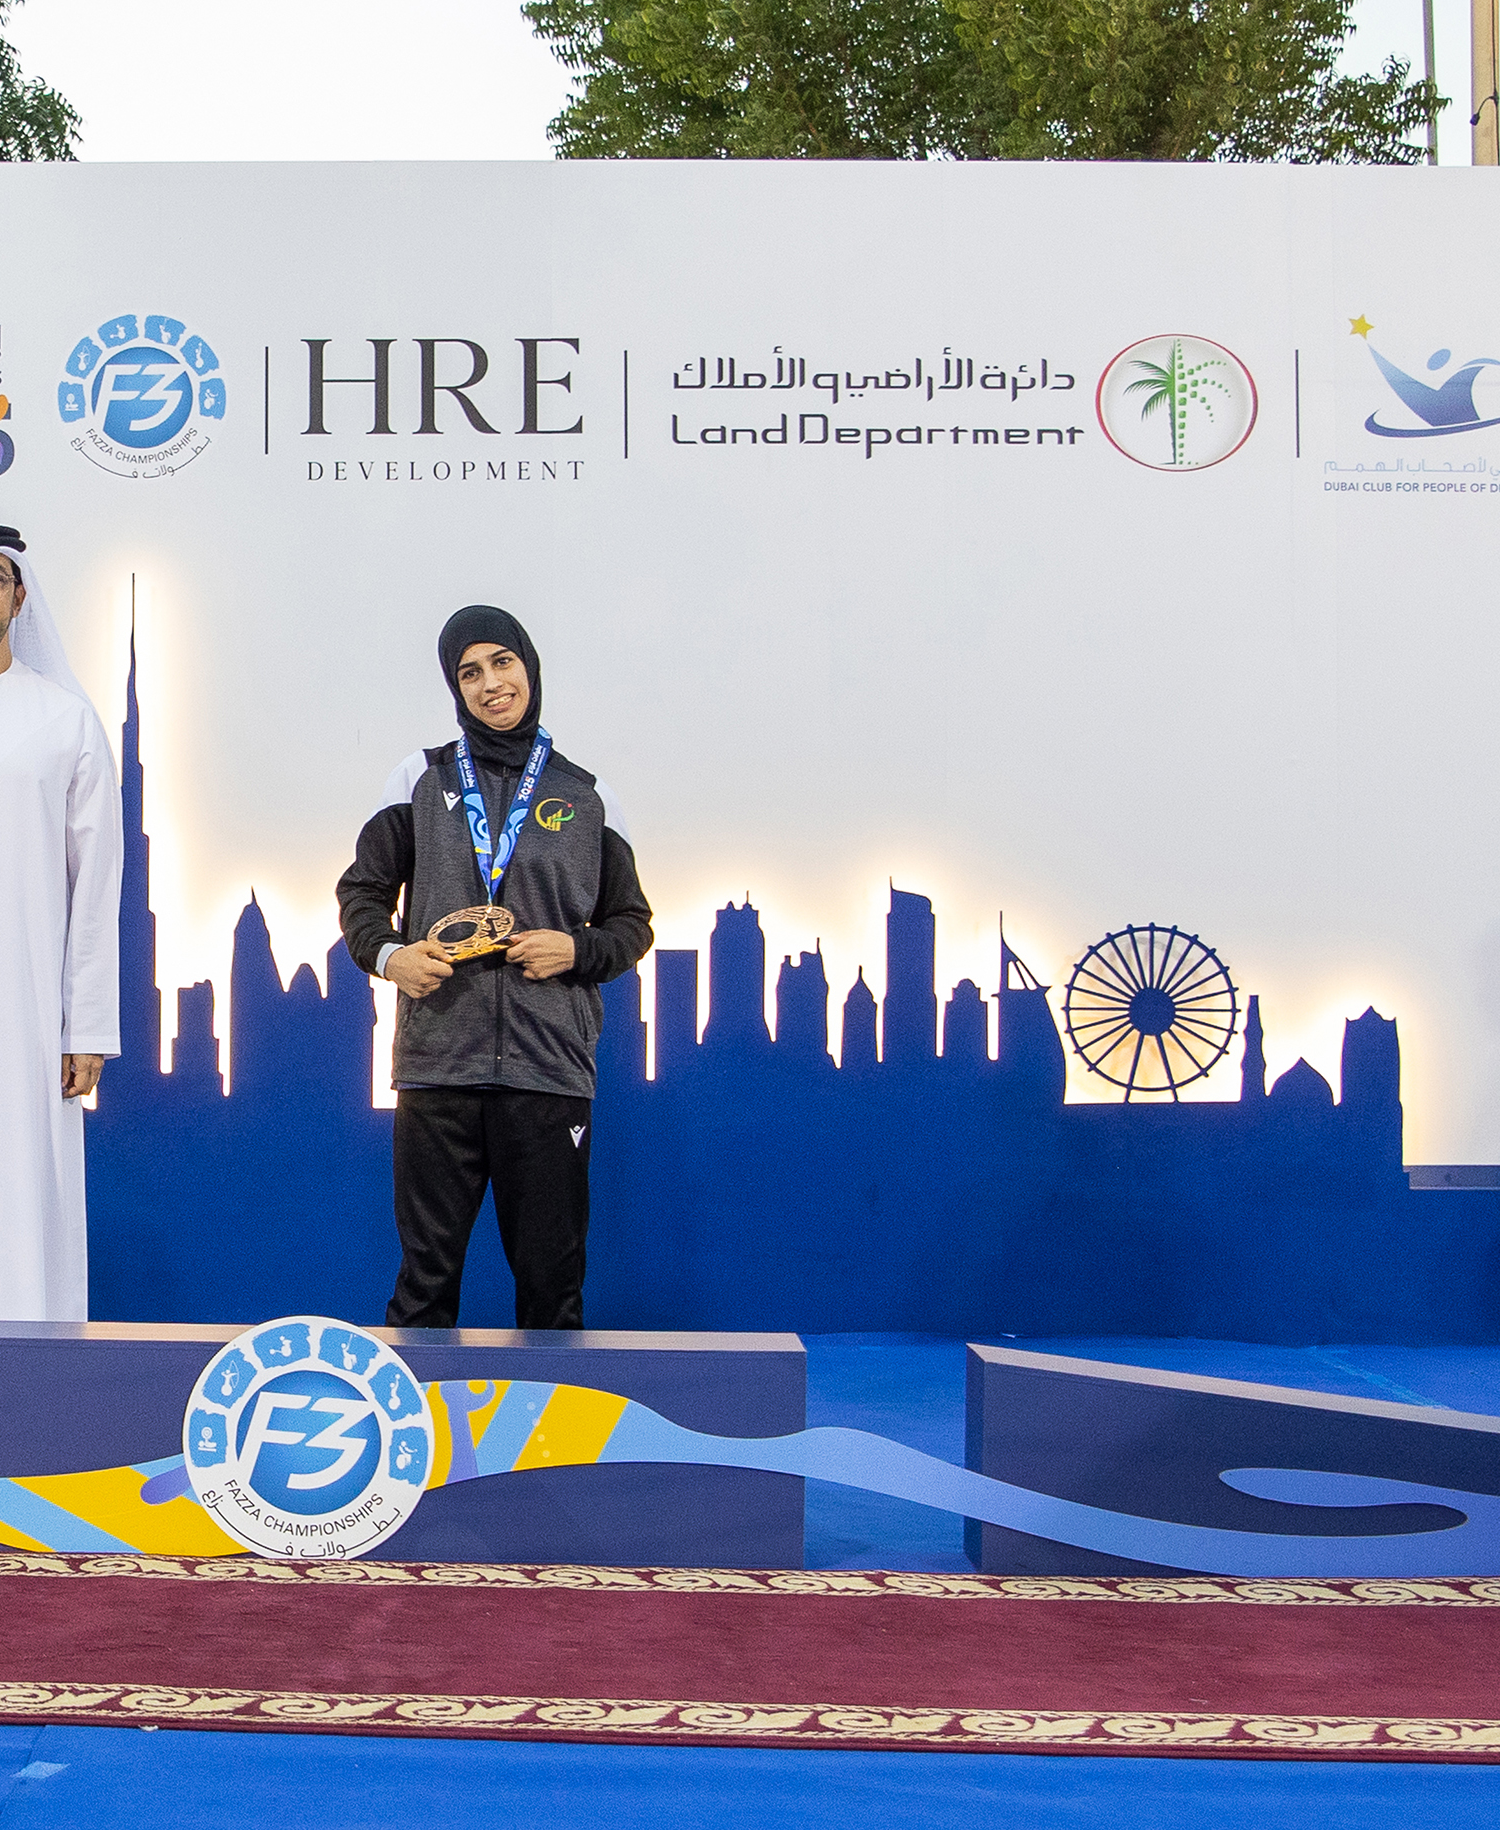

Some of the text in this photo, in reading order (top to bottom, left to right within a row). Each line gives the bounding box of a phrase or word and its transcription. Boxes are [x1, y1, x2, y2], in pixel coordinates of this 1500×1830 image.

[301, 338, 583, 435] HRE
[674, 346, 1075, 404] دائرة الأراضي والأملاك
[85, 427, 198, 464] FAZZA CHAMPIONSHIPS
[672, 413, 1084, 459] Land Department
[308, 461, 584, 480] DEVELOPMENT
[1324, 482, 1359, 491] DUBAI
[1362, 482, 1392, 492] CLUB
[1396, 482, 1419, 492] FOR
[1423, 483, 1466, 492] PEOPLE
[1470, 483, 1486, 493] OF
[224, 1478, 385, 1537] FAZZA CHAMPIONSHIPS
